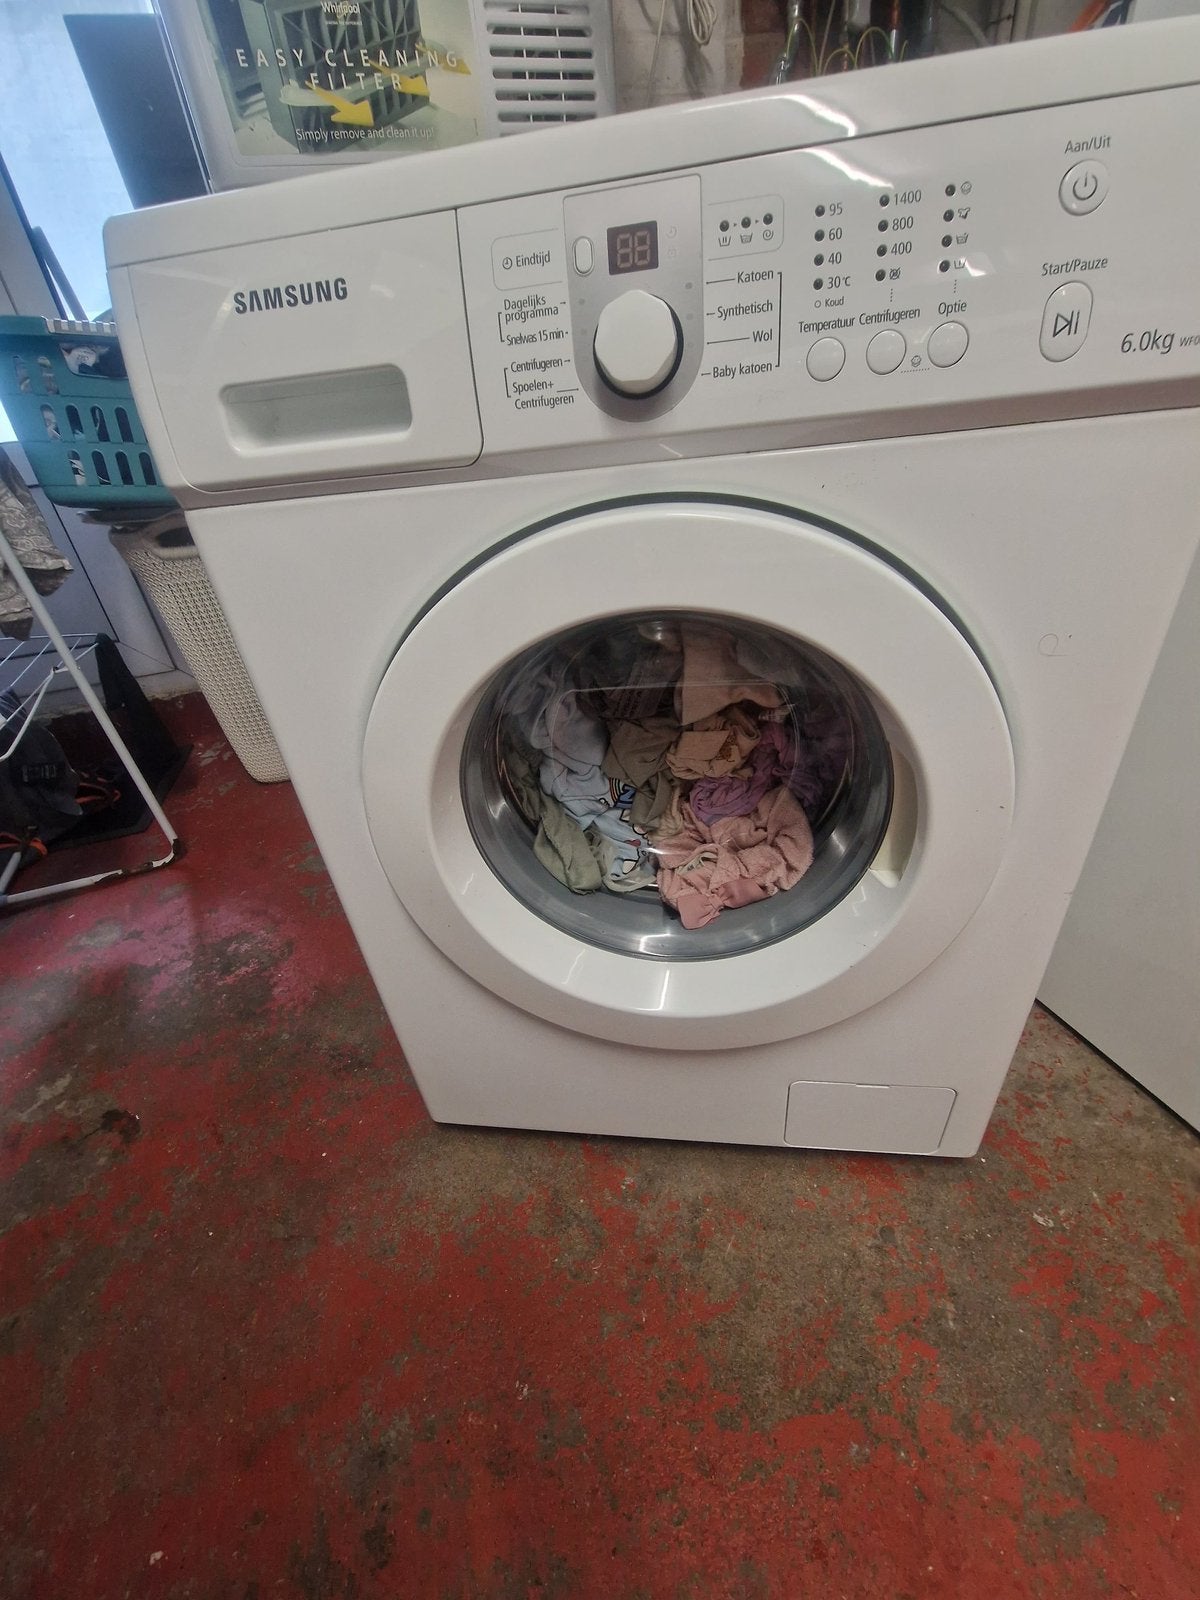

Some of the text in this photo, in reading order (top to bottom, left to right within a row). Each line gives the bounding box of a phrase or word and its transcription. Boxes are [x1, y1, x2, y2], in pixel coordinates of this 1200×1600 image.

[235, 48, 458, 68] EASY CLEANING
[310, 72, 402, 91] FILTER
[295, 126, 435, 143] Simply remove and clean it up!
[1064, 135, 1111, 154] Aan/Uit
[893, 189, 922, 206] 1400
[828, 202, 843, 217] 95
[892, 215, 914, 232] 800
[828, 226, 843, 241] 60
[890, 240, 912, 256] 400
[515, 250, 551, 269] Eindtijd
[827, 251, 842, 265] 40
[1041, 256, 1109, 277] Start/Pauze
[737, 269, 774, 284] Katoen
[233, 277, 348, 315] SAMSUNG
[503, 294, 547, 312] Dagelijks
[824, 295, 845, 308] Koud
[504, 305, 559, 325] programma
[717, 299, 773, 321] Synthetisch
[938, 299, 967, 318] Optie
[798, 308, 921, 334] Temperatuur Centrifugeren
[506, 327, 564, 346] Snelwas 15 min
[752, 328, 773, 345] Wol
[1120, 328, 1175, 355] 6.0kg
[510, 357, 563, 373] Centrifugeren
[712, 361, 772, 381] Baby katoen
[512, 379, 554, 395] Spoelen+
[514, 394, 575, 410] Centrifugeren
